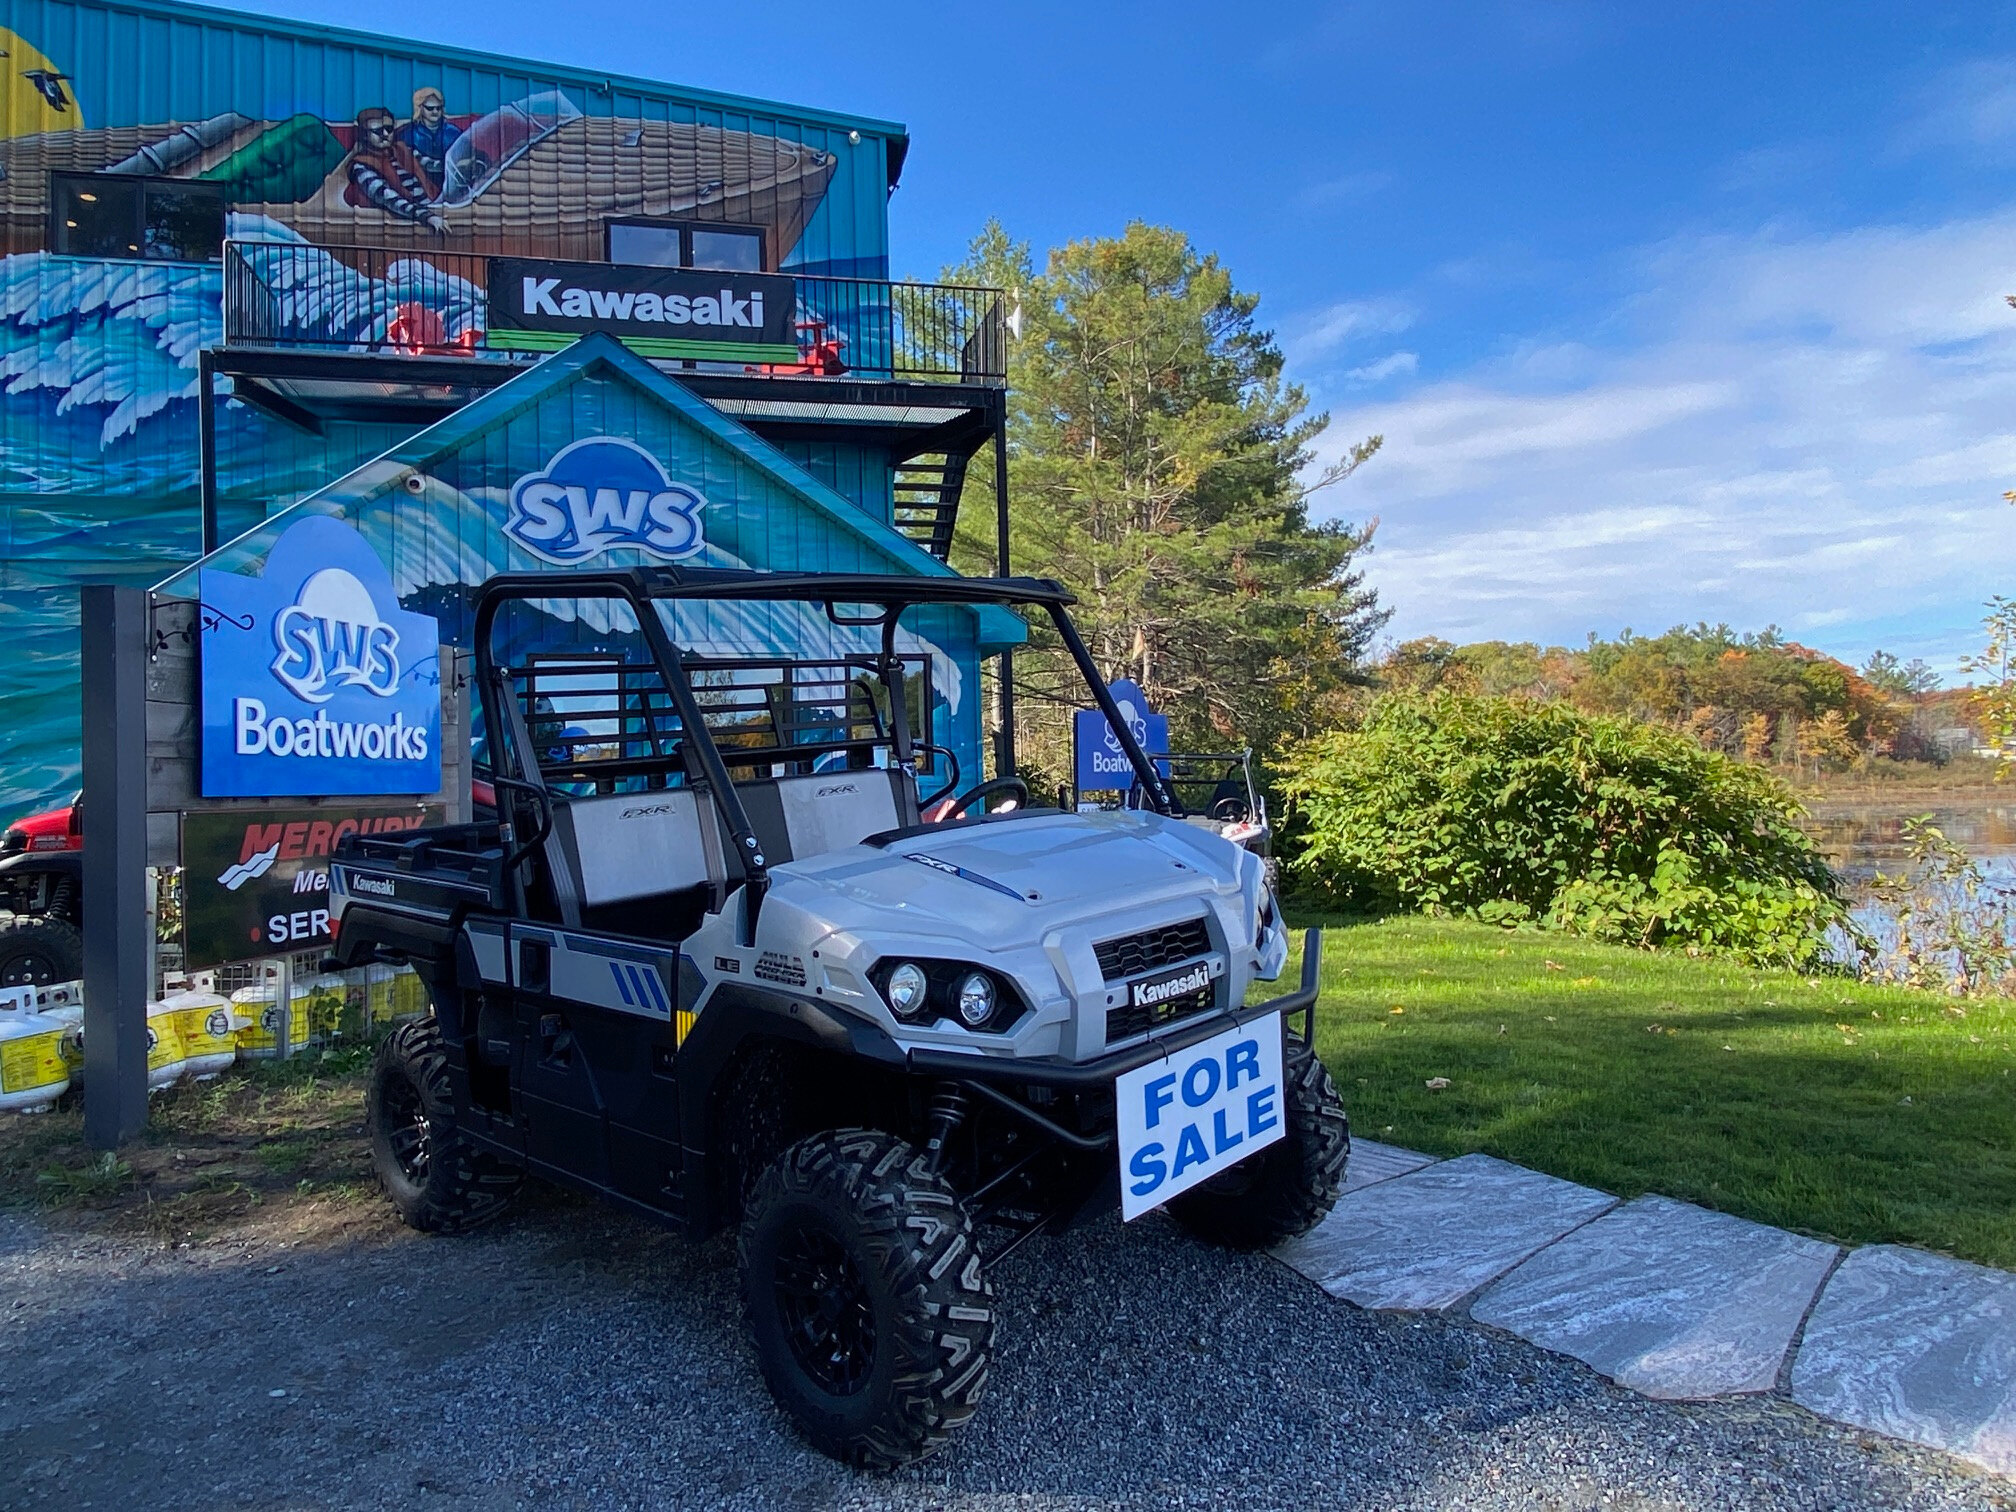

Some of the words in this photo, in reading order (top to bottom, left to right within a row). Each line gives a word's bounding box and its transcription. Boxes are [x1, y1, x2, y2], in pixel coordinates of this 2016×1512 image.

[522, 276, 764, 329] Kawasaki
[515, 480, 697, 553] SWS
[270, 604, 401, 704] SWS
[235, 698, 428, 760] Boatworks
[1093, 751, 1134, 773] Boatw
[353, 873, 395, 896] Kawasaki
[715, 957, 739, 973] LE
[1133, 965, 1209, 1007] Kawasaki
[1144, 1039, 1261, 1131] FOR
[1129, 1084, 1278, 1196] SALE
